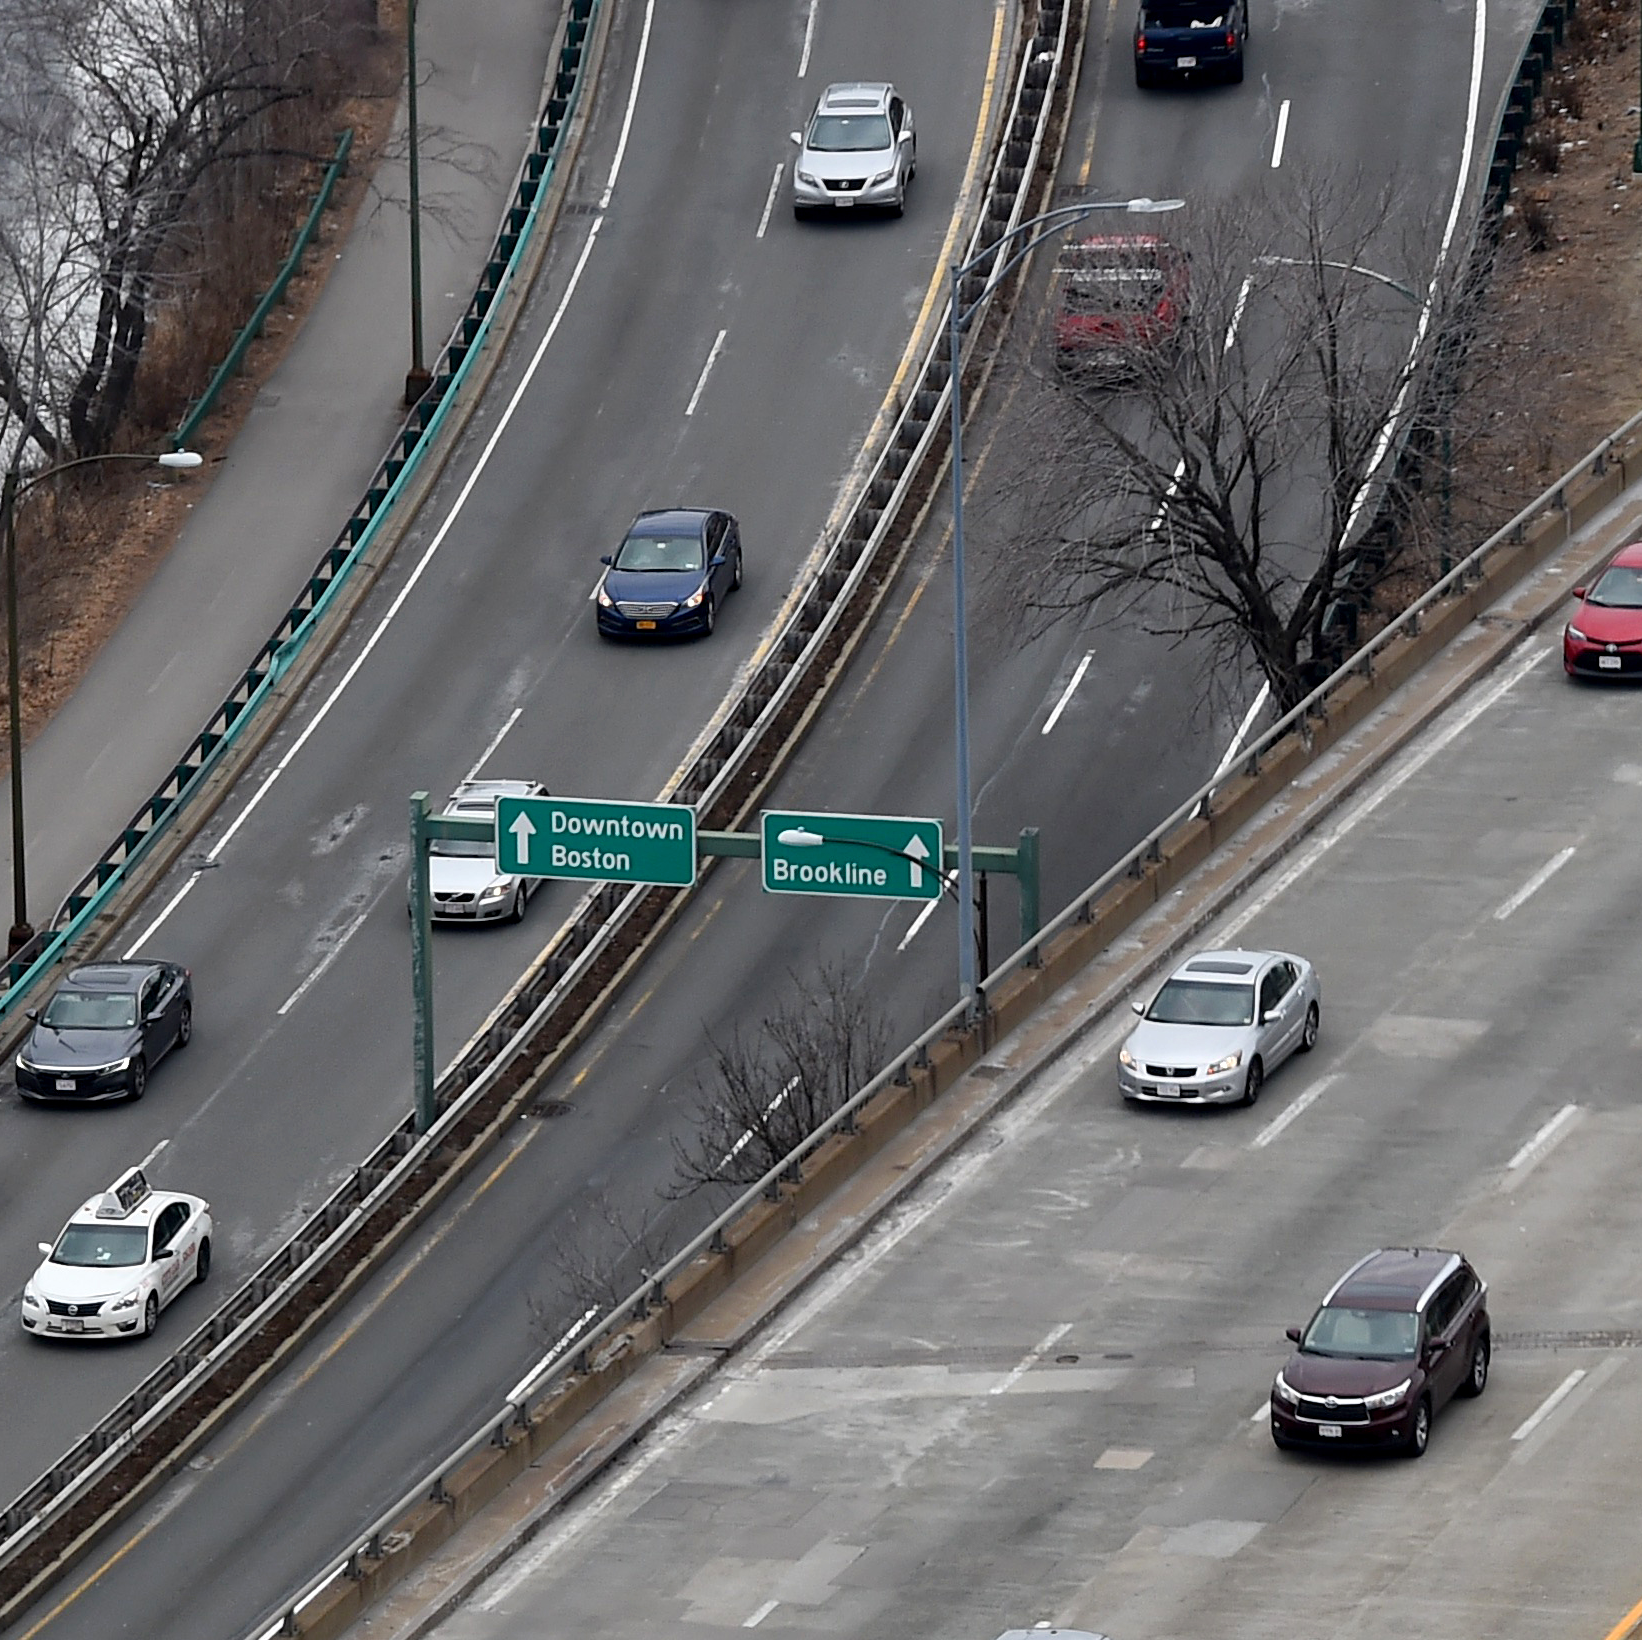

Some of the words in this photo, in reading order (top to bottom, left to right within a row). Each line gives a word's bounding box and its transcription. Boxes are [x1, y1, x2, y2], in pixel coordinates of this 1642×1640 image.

[551, 811, 683, 840] Downtown
[551, 845, 630, 870] Boston
[773, 858, 887, 885] Brookline
